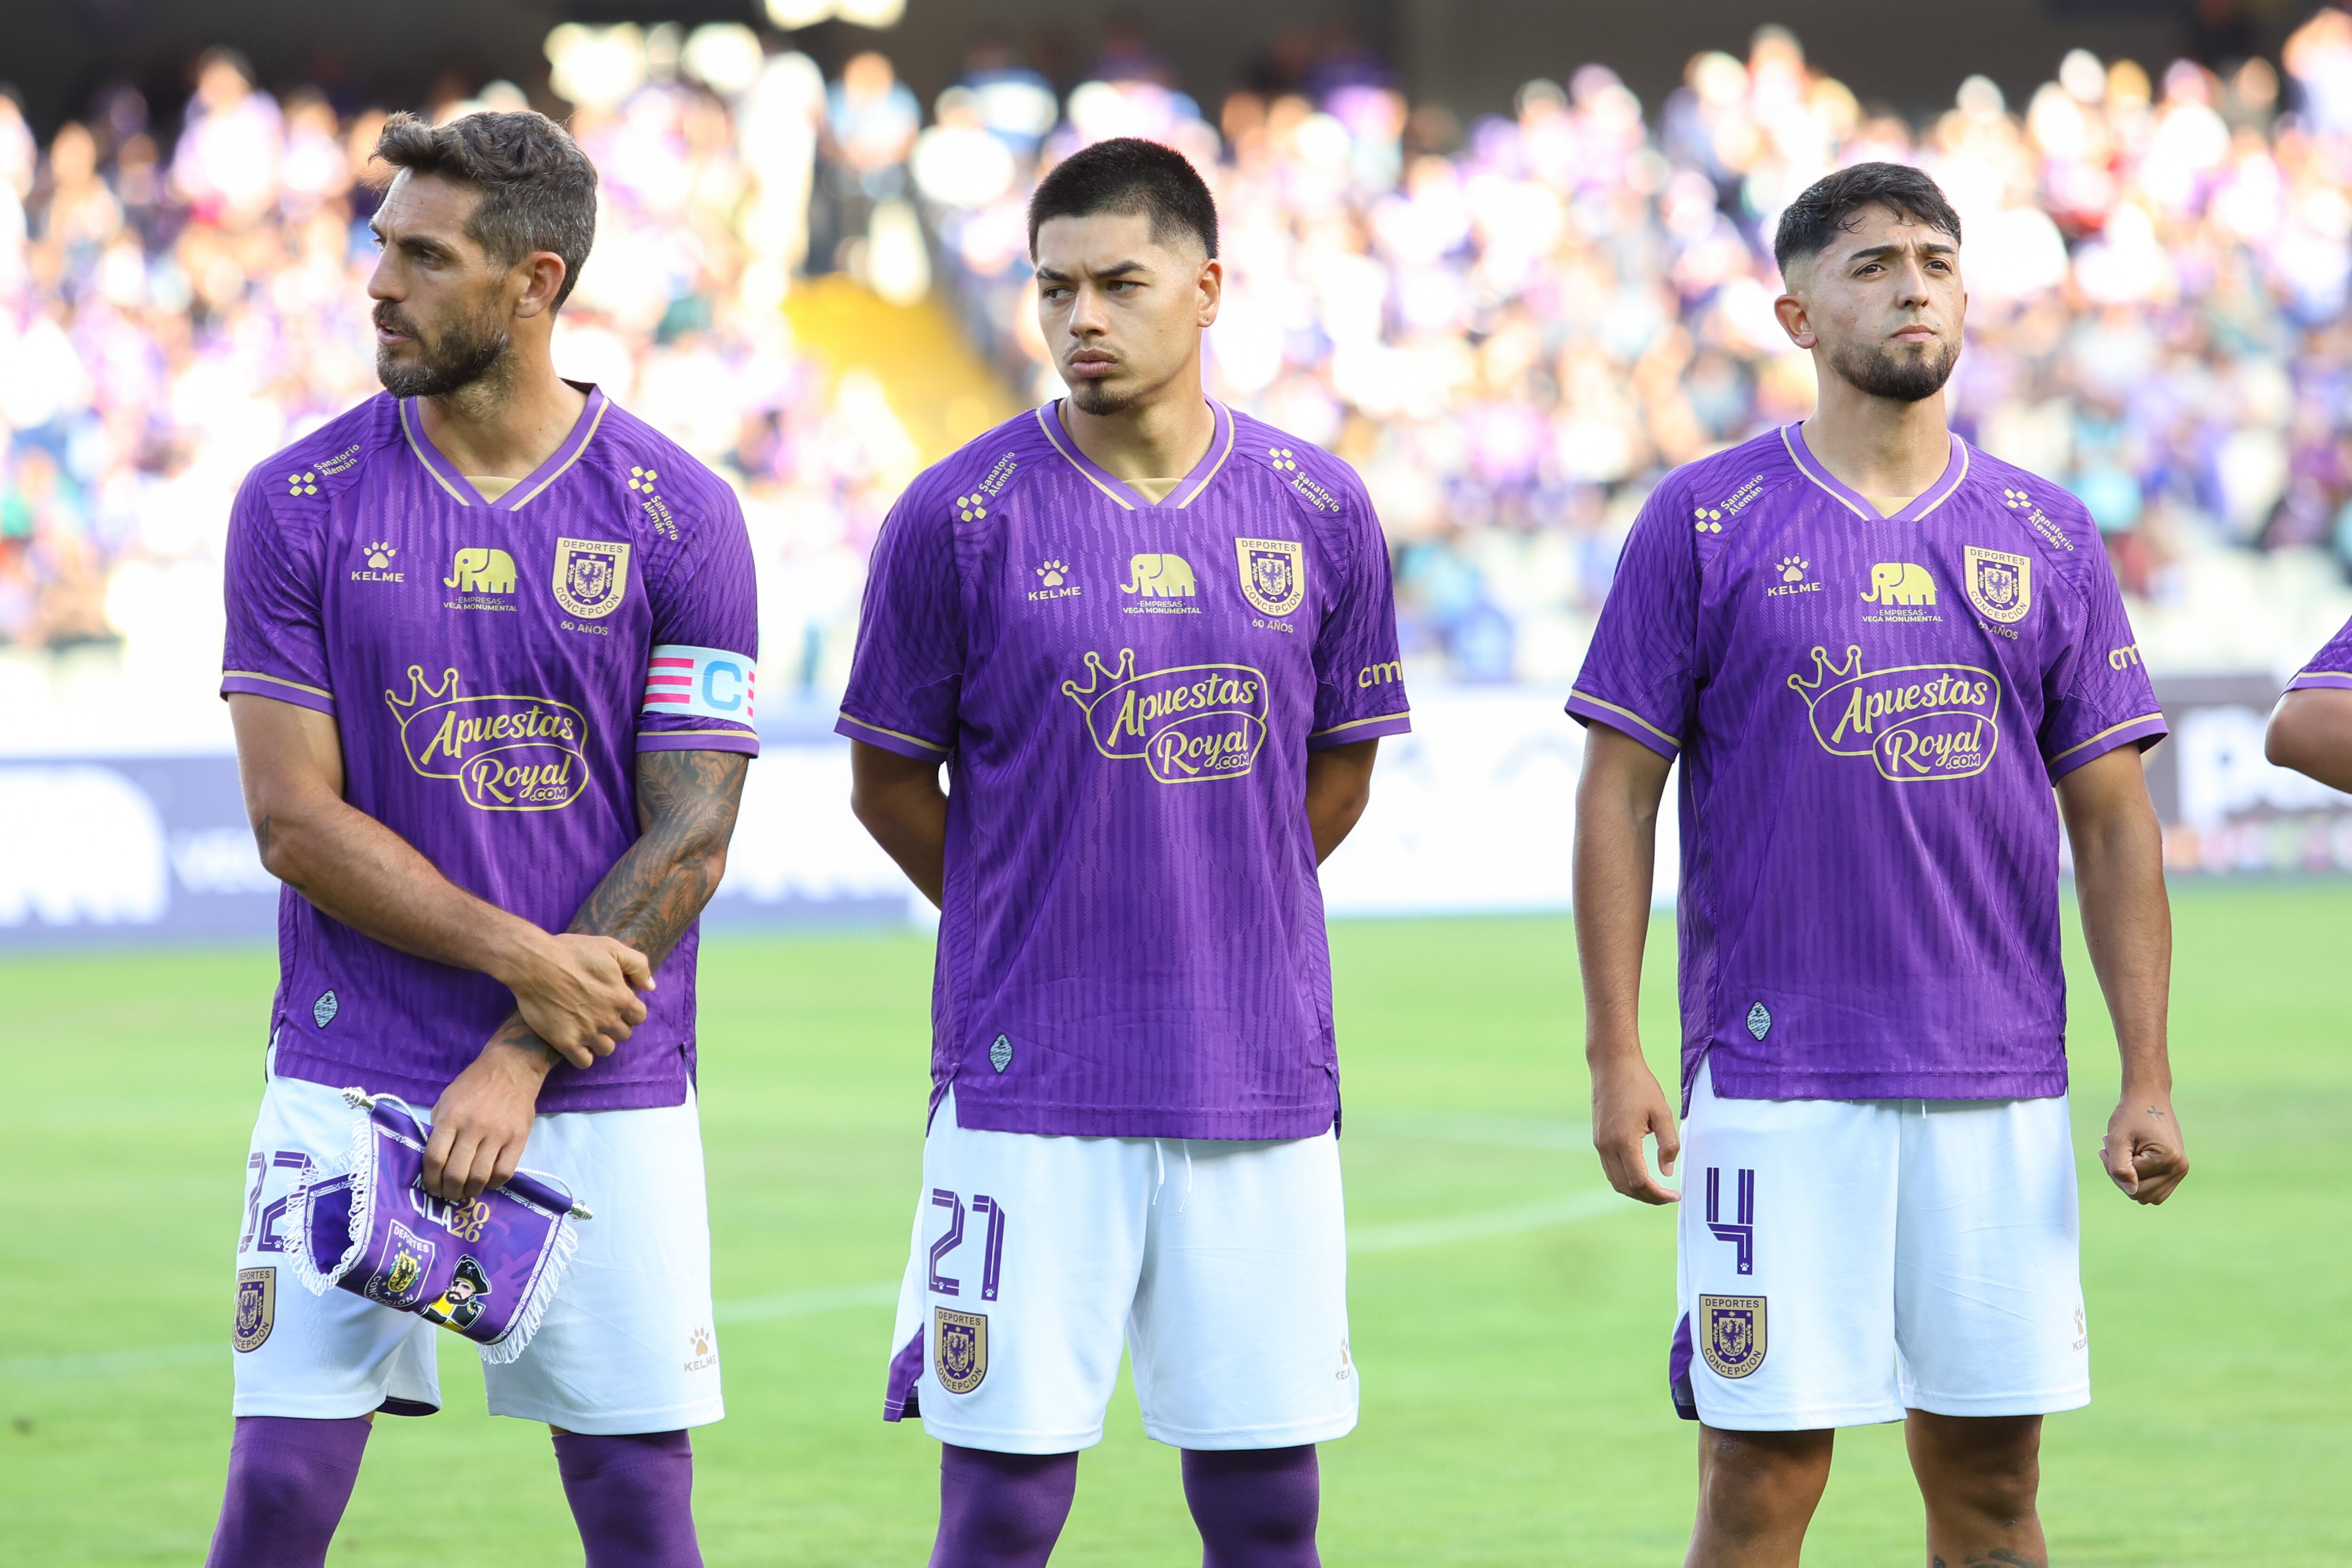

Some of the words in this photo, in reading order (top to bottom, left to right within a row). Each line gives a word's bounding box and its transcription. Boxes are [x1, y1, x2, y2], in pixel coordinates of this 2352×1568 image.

[313, 444, 359, 470] Sanatorio
[322, 458, 357, 476] Alemán
[979, 452, 1016, 493] Sanatorio
[988, 461, 1017, 497] Alemán
[1291, 478, 1326, 511] Alemán
[1296, 471, 1340, 513] Sanatorio
[1720, 474, 1764, 510] Sanatorio
[1729, 485, 1763, 516] Alemán
[641, 501, 665, 535] Alemán
[650, 494, 678, 541] Sanatorio
[2027, 515, 2060, 549] Alemán
[2033, 509, 2074, 551] Sanatorio
[564, 540, 624, 553] DEPORTES
[1242, 540, 1297, 552] DEPORTES
[1970, 549, 2025, 565] DEPORTES
[351, 571, 404, 582] KELME
[1767, 582, 1821, 597] KELME
[556, 586, 620, 616] CONCEPCION
[1028, 586, 1081, 601] KELME
[1245, 585, 1301, 613] CONCEPCION
[1971, 591, 2027, 620] CONCEPCION
[560, 620, 575, 631] 60
[577, 621, 608, 636] AÑOS
[1252, 619, 1264, 628] 60
[1267, 619, 1294, 633] AÑOS
[1989, 624, 2018, 640] AÑOS
[701, 660, 742, 712] C
[1359, 661, 1402, 688] cm
[1107, 673, 1258, 747] Apuestas
[1831, 673, 1988, 743] Apuestas
[420, 705, 574, 765] Apuestas
[1157, 718, 1248, 775] Royal
[1884, 719, 1982, 773] Royal
[1215, 753, 1249, 770] .COM
[1946, 753, 1980, 769] .COM
[471, 754, 572, 804] Royal
[530, 787, 567, 802] .COM
[455, 1197, 490, 1224] 20
[1706, 1167, 1755, 1275] 4
[394, 1226, 429, 1253] DEPORTES
[450, 1215, 484, 1243] 26
[929, 1188, 1005, 1302] 21
[368, 1276, 414, 1305] CONCEPCION
[1705, 1298, 1760, 1308] DEPORTES
[938, 1311, 981, 1326] DEPORTES
[683, 1354, 717, 1373] KELME
[936, 1360, 983, 1391] CONCEPCION
[1704, 1347, 1762, 1376] CONCEPCION
